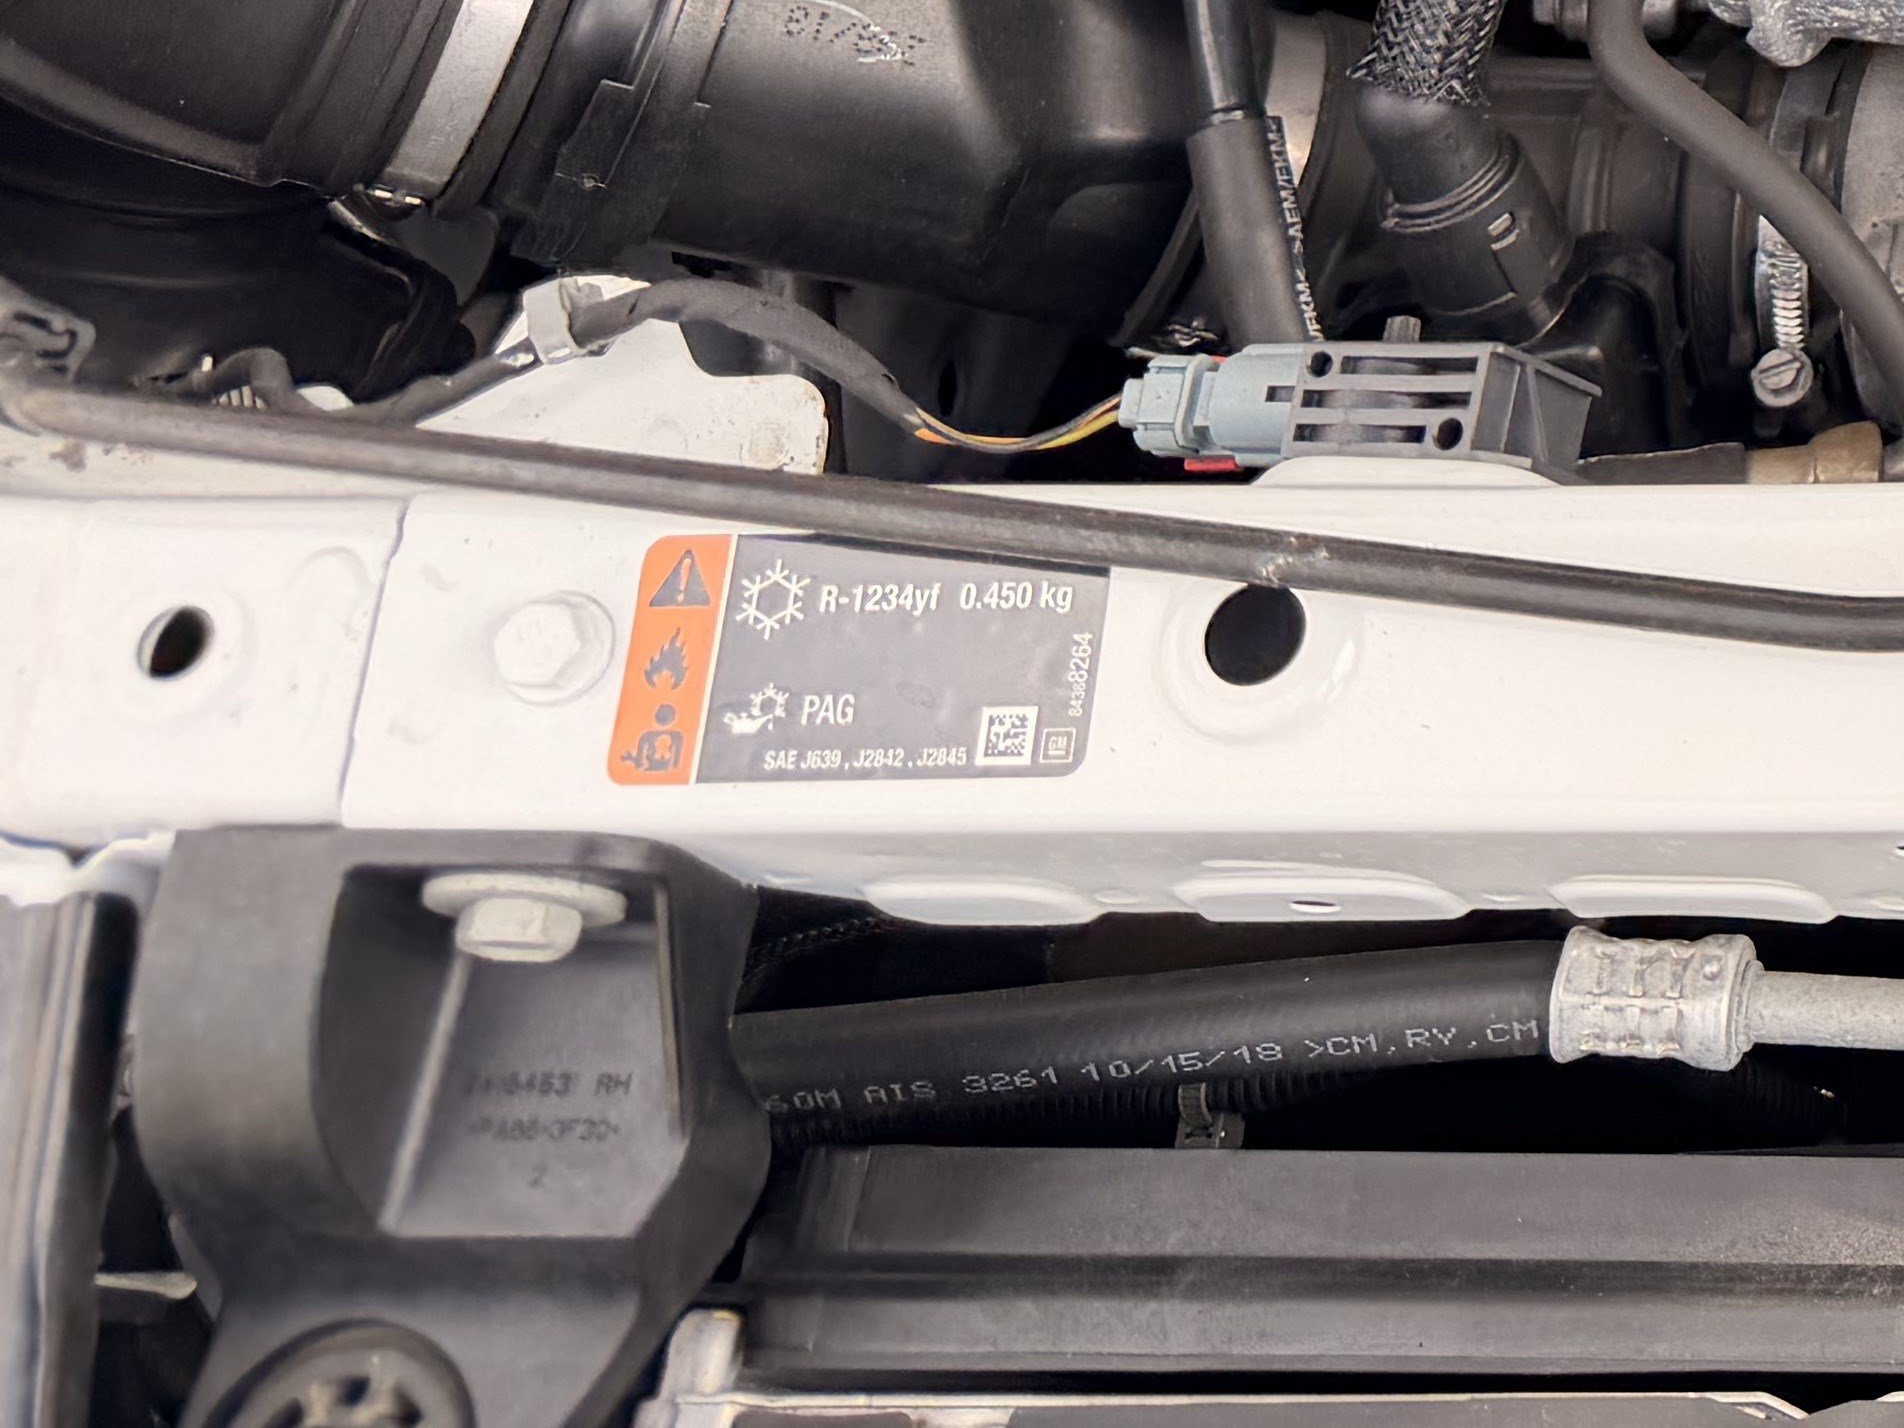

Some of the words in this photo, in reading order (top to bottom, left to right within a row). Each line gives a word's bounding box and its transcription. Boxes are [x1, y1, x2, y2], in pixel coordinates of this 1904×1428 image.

[818, 583, 942, 617] R-1234yf
[959, 582, 1033, 611] 0.450
[1039, 580, 1074, 613] kg
[801, 694, 856, 726] PAG
[763, 750, 796, 770] SAE
[1080, 1043, 1283, 1083] 10/15/18
